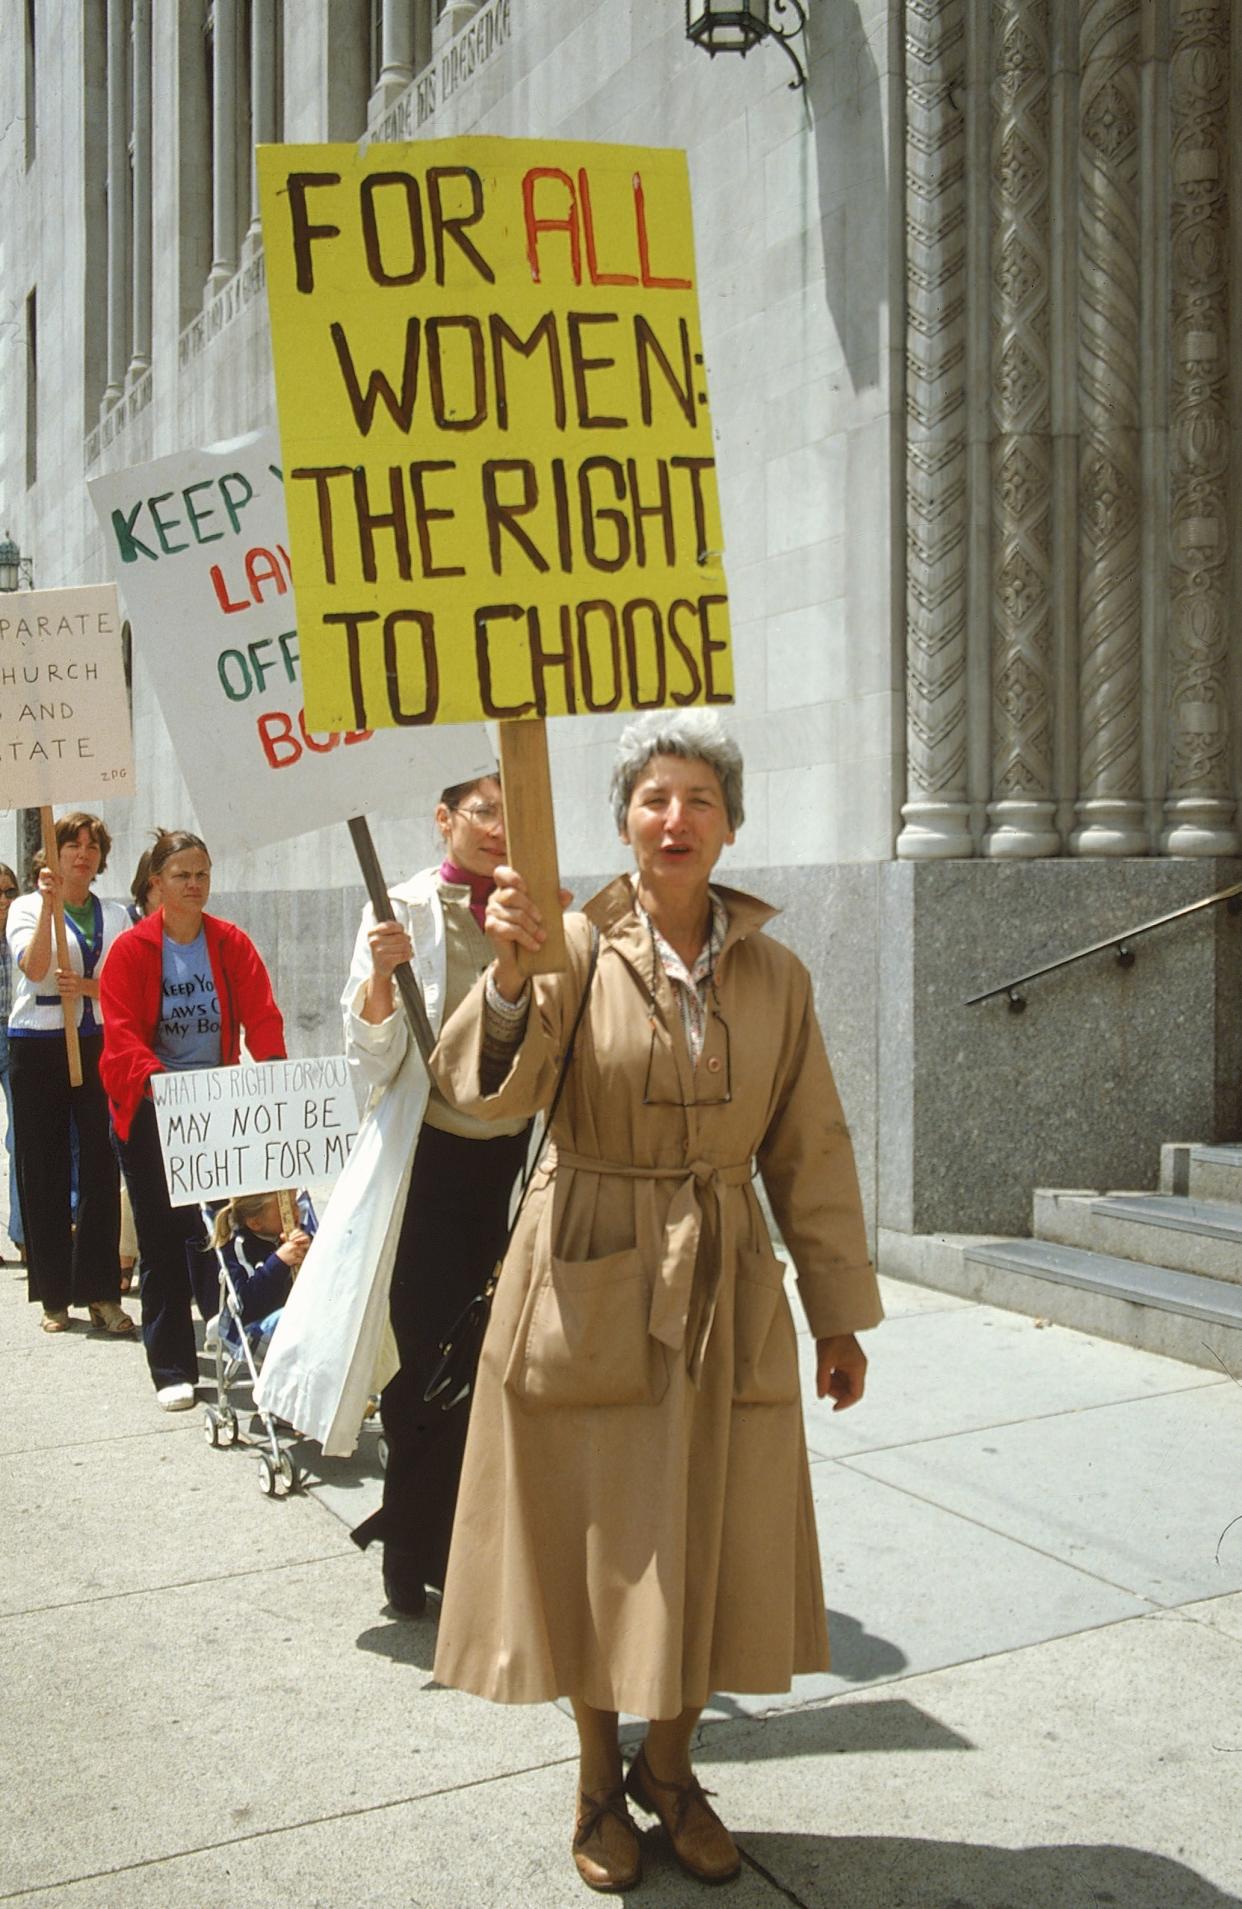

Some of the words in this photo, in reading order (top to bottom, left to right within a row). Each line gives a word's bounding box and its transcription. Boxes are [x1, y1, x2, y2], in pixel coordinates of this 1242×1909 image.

[286, 166, 495, 293] FOR
[522, 167, 692, 288] ALL
[331, 311, 708, 437] WOMEN:
[112, 472, 253, 563] KEEP
[291, 460, 465, 585] THE
[482, 456, 715, 575] RIGHT
[0, 613, 113, 640] PARATE
[2, 663, 98, 685] HURCH
[217, 631, 300, 701] OFF
[323, 610, 439, 730] TO
[474, 595, 734, 719] CHOOSE
[18, 703, 74, 721] AND
[0, 738, 95, 761] TATE
[153, 1073, 198, 1106] WHAT
[207, 1075, 222, 1101] IS
[230, 1064, 275, 1098] RIGHT
[283, 1061, 313, 1091] FOR
[314, 1058, 348, 1089] YOU
[167, 1112, 211, 1146] MAY
[232, 1102, 288, 1138] NOT
[304, 1097, 340, 1129] BE
[170, 1146, 250, 1195] RIGHT
[265, 1139, 315, 1181] FOR
